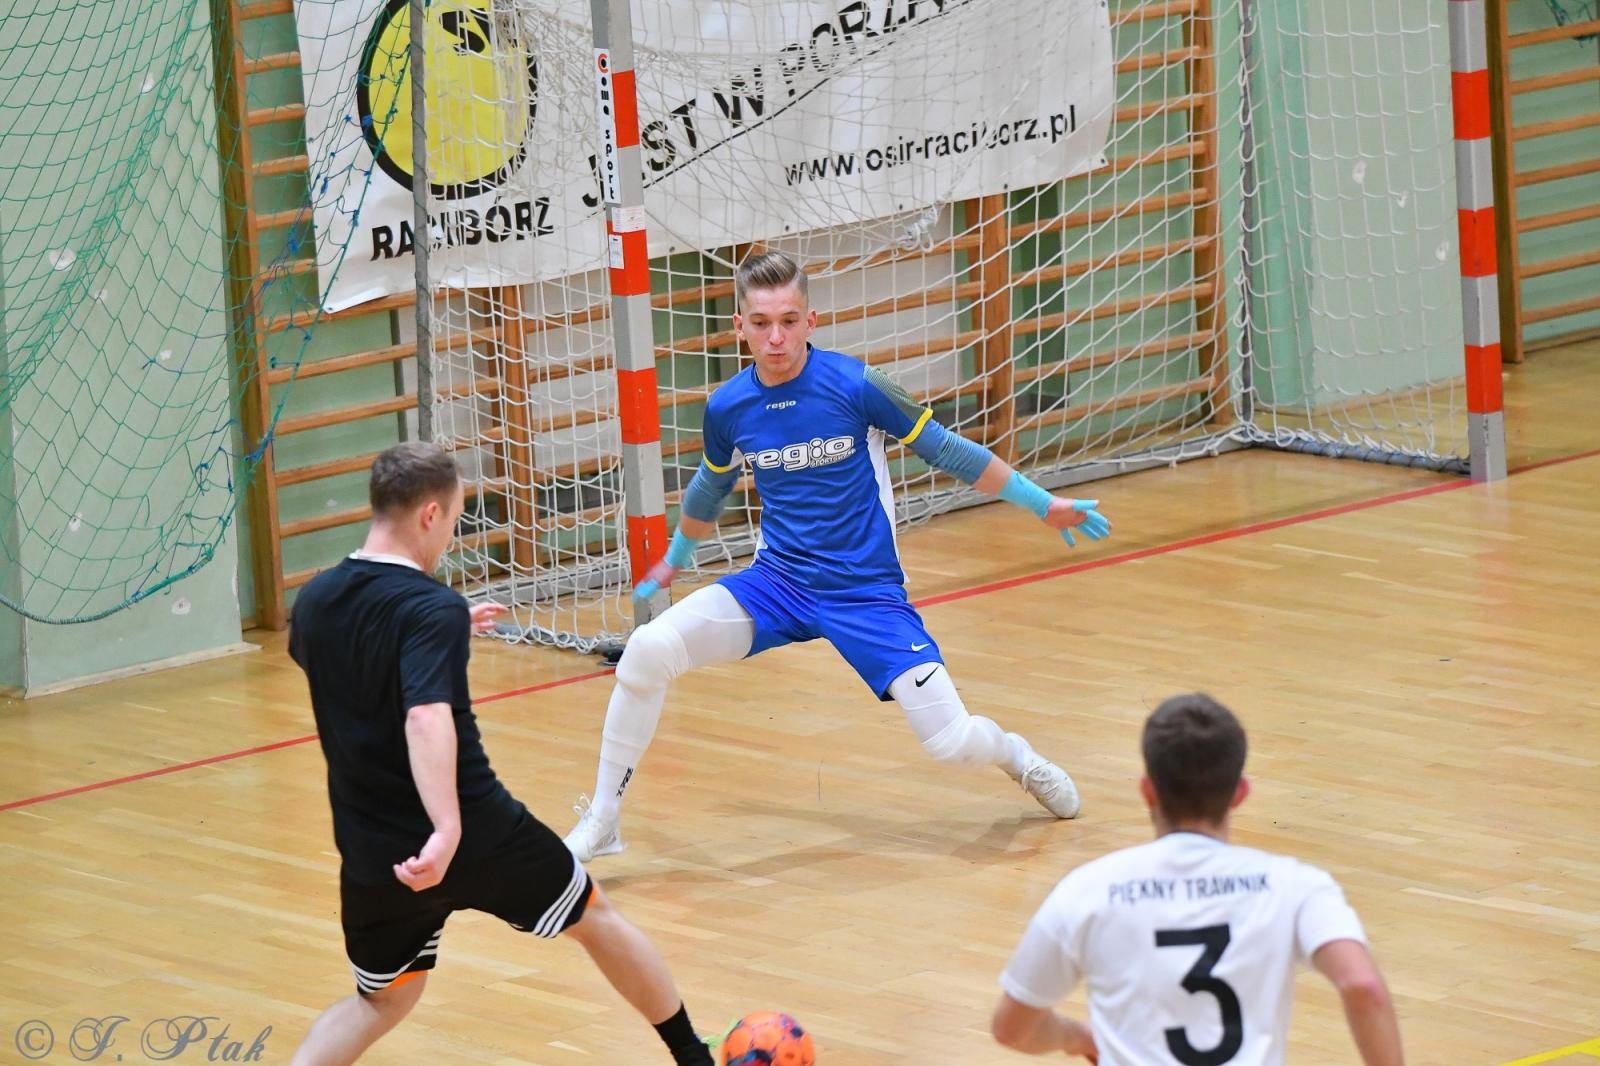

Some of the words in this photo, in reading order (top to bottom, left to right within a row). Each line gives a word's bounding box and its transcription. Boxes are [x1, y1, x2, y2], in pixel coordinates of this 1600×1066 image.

[582, 98, 697, 208] JST
[766, 400, 797, 411] regio
[1184, 873, 1271, 900] TRAWNIK
[1154, 922, 1244, 1066] 3
